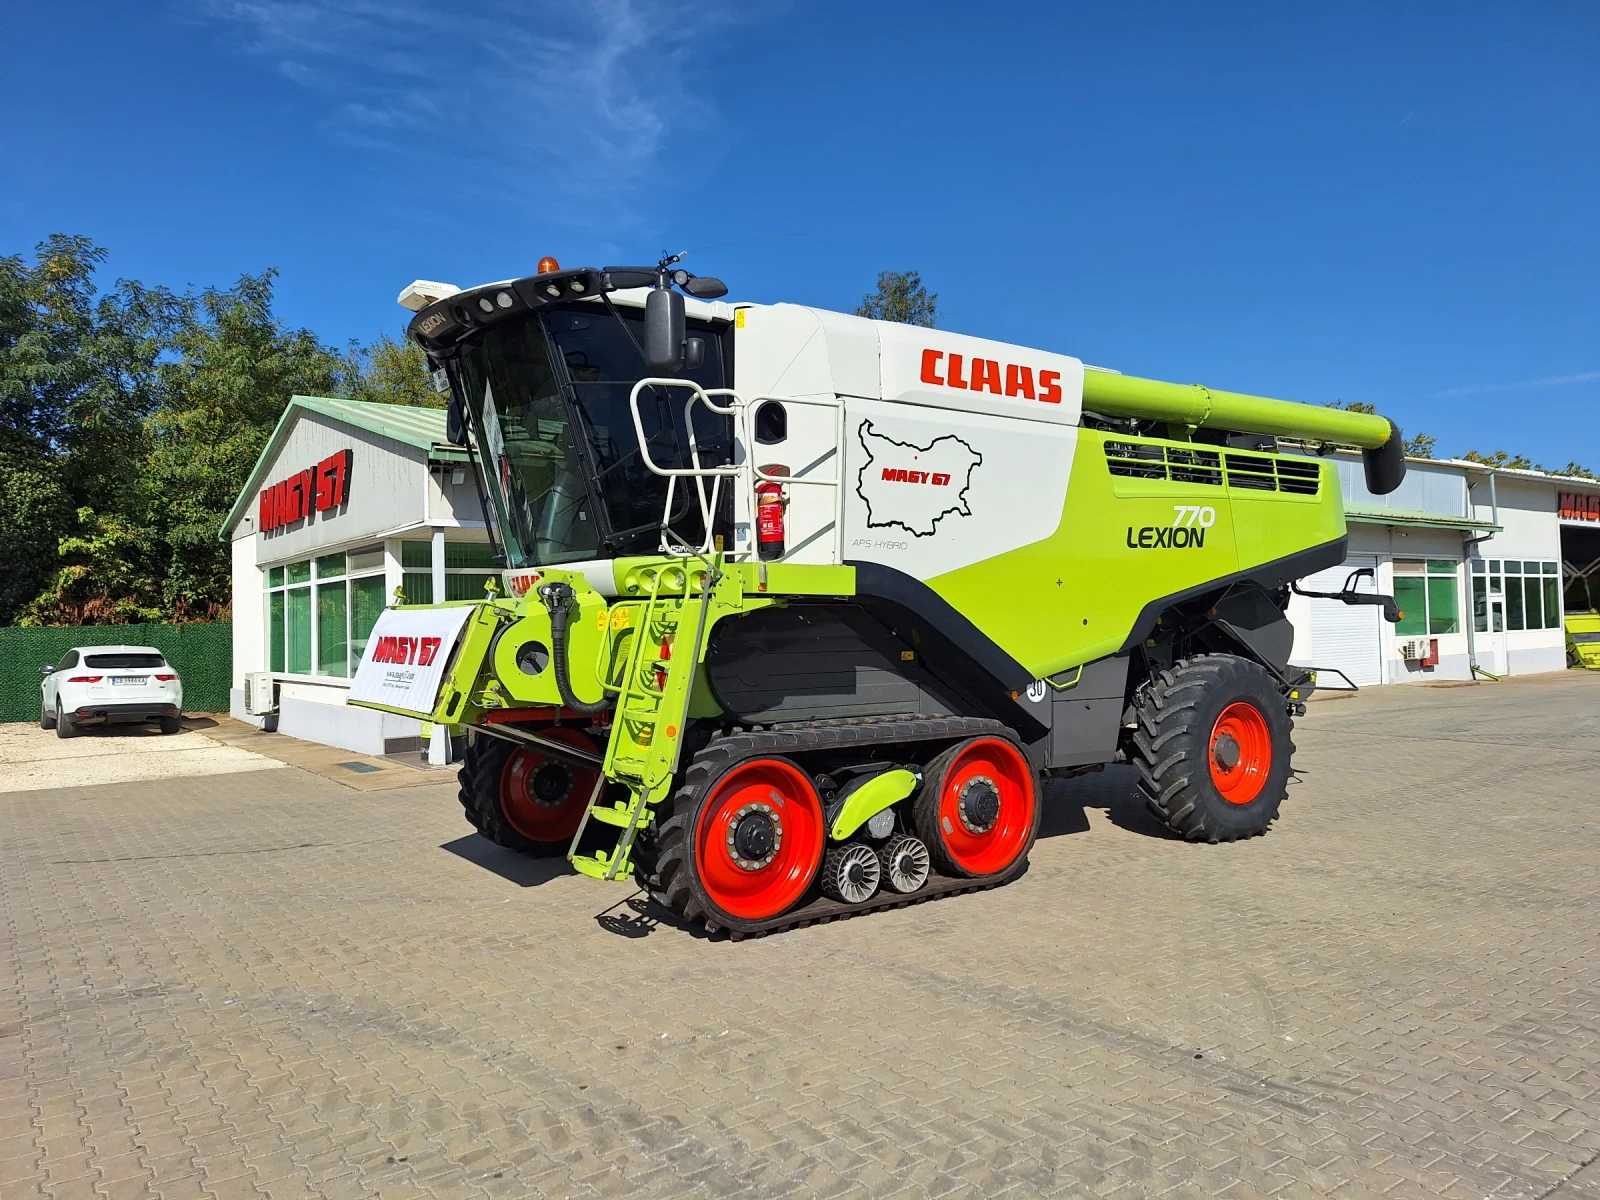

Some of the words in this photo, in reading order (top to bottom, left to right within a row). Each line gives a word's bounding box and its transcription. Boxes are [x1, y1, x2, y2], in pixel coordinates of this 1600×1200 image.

[418, 311, 447, 334] LEXION
[920, 348, 1062, 404] CLAAS
[881, 468, 930, 484] MAGY
[259, 466, 317, 533] MAGY
[316, 449, 352, 512] 57
[1172, 505, 1216, 527] 770
[852, 538, 872, 548] APS
[874, 540, 908, 550] HYBRID
[1126, 527, 1205, 548] LEXION
[658, 544, 706, 553] BSINS
[371, 636, 419, 666] MAGY
[417, 636, 442, 667] 57
[1030, 679, 1043, 697] 30
